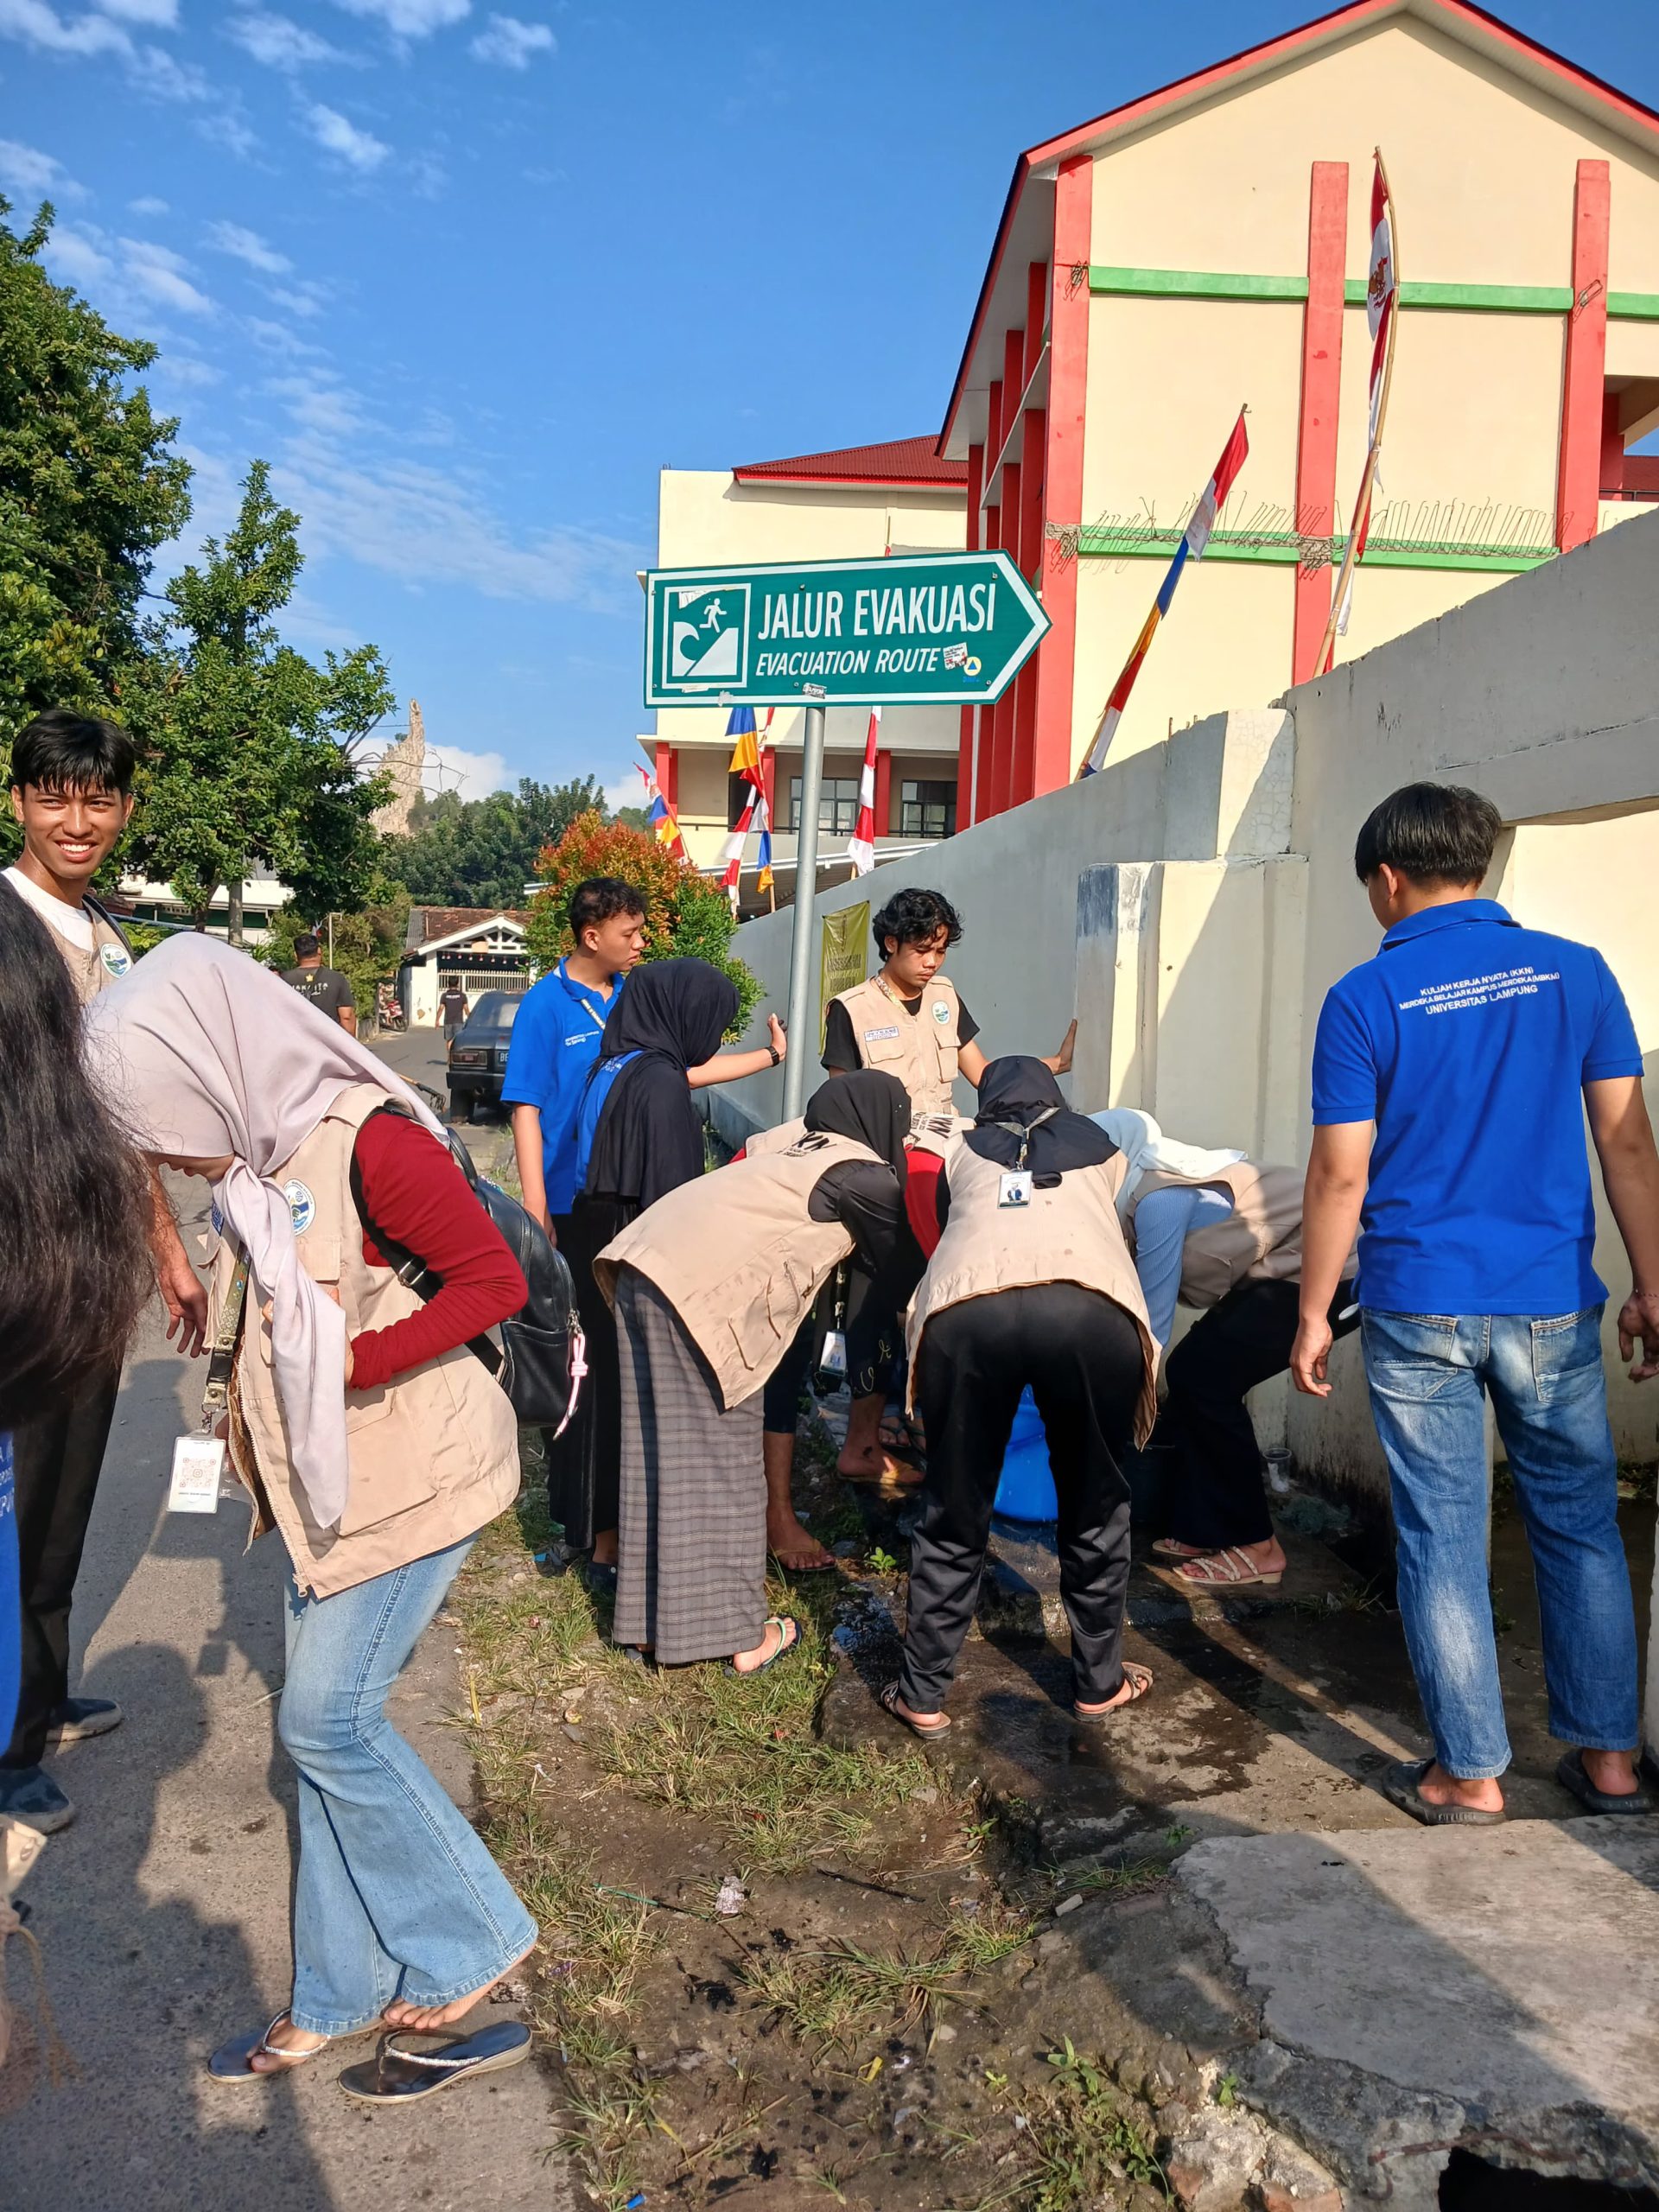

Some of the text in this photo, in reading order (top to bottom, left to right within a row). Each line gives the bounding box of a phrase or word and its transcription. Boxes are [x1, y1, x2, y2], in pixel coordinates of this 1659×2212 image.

[758, 583, 996, 640] JALUR EVAKUASI
[755, 650, 871, 677] EVACUATION
[874, 647, 941, 673] ROUTE
[1420, 966, 1534, 996] KULIAH KERJA NYATA (KKN)
[1399, 997, 1434, 1010] MERDEKA
[1433, 989, 1466, 1002] BELAJAR
[1466, 983, 1497, 995] KAMPUS
[1425, 984, 1538, 1015] UNIVERSITAS LAMPUNG
[791, 1131, 837, 1152] KN
